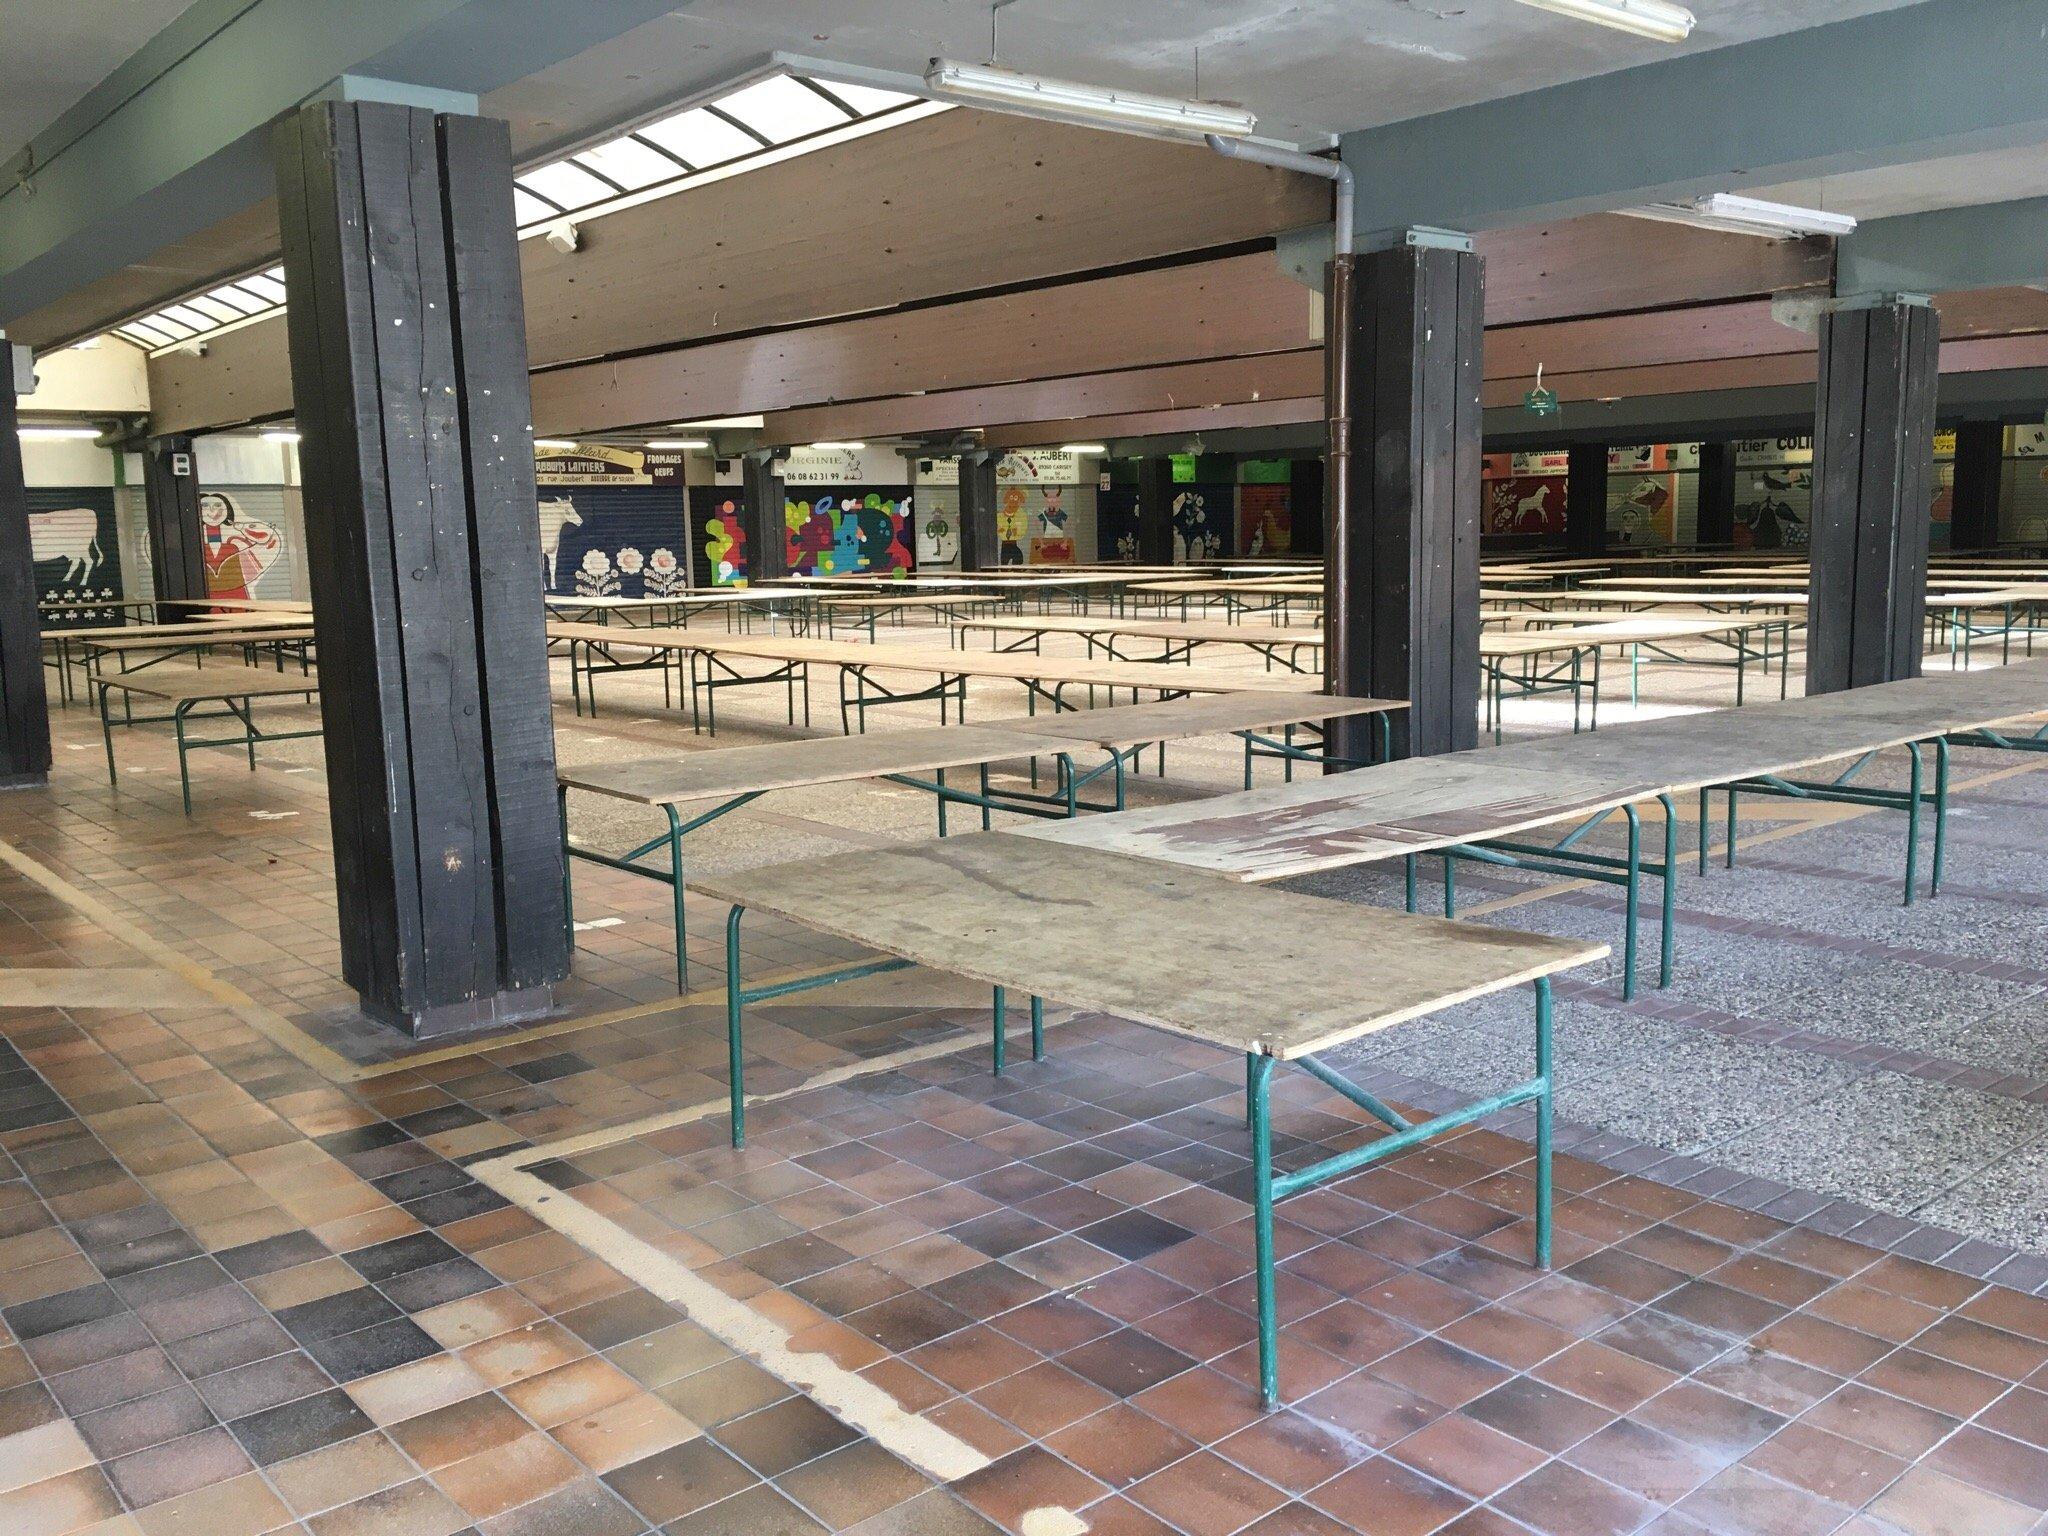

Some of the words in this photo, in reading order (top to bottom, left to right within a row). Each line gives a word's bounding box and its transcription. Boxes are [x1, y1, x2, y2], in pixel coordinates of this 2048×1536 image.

[646, 454, 682, 464] FROMAGES
[1040, 450, 1073, 460] AUBERT
[567, 461, 605, 474] LAITIERS
[654, 467, 674, 477] OEUFS
[787, 472, 796, 480] 06
[798, 472, 807, 480] 08
[809, 472, 818, 480] 62
[820, 472, 828, 480] 31
[831, 472, 839, 480] 99
